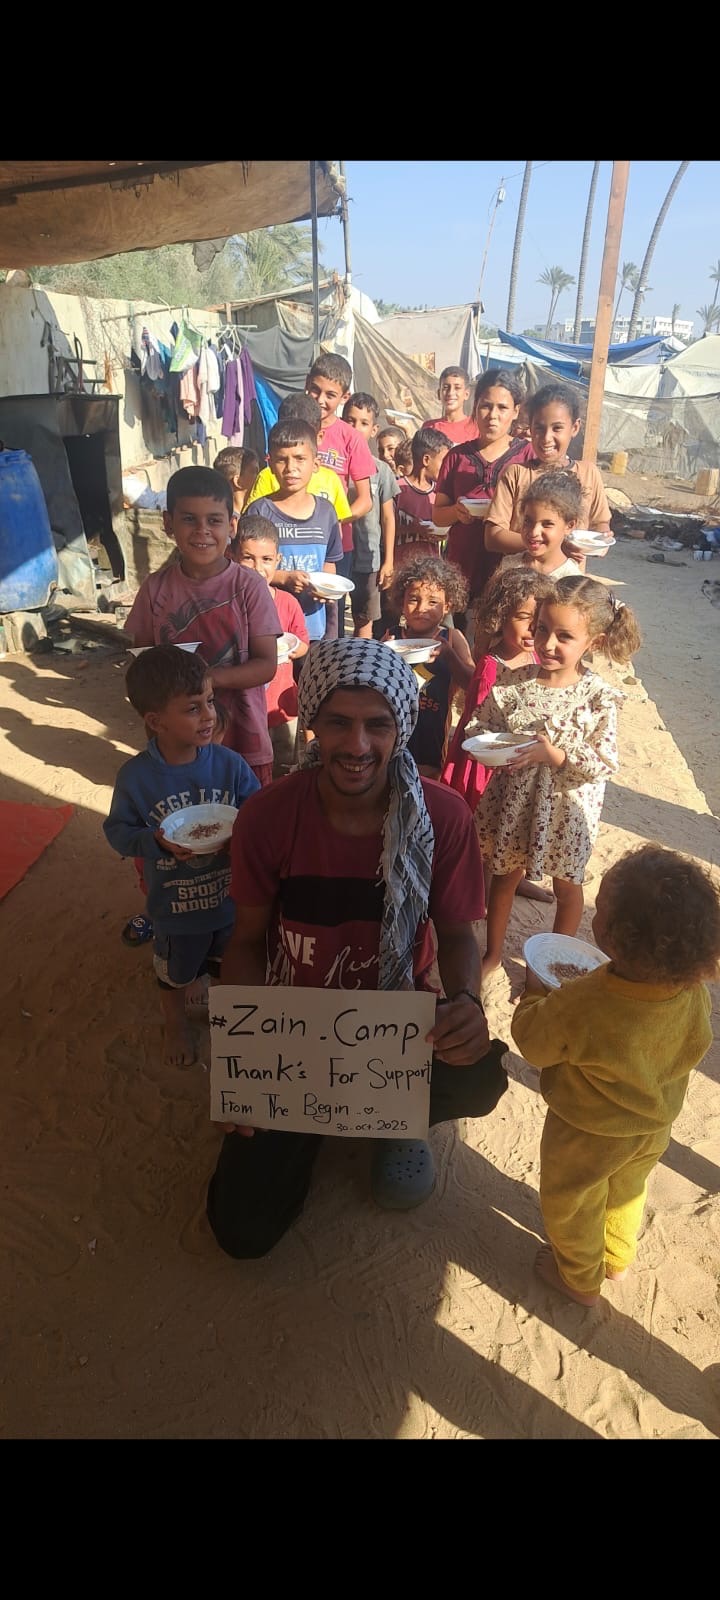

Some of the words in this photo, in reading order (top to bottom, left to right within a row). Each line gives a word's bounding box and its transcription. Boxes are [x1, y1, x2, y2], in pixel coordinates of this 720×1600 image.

[178, 875, 232, 900] SPORTS
[216, 1054, 307, 1082] Thank's
[329, 1057, 360, 1088] For
[366, 1058, 433, 1091] Support
[220, 1090, 252, 1114] From
[261, 1093, 289, 1120] The
